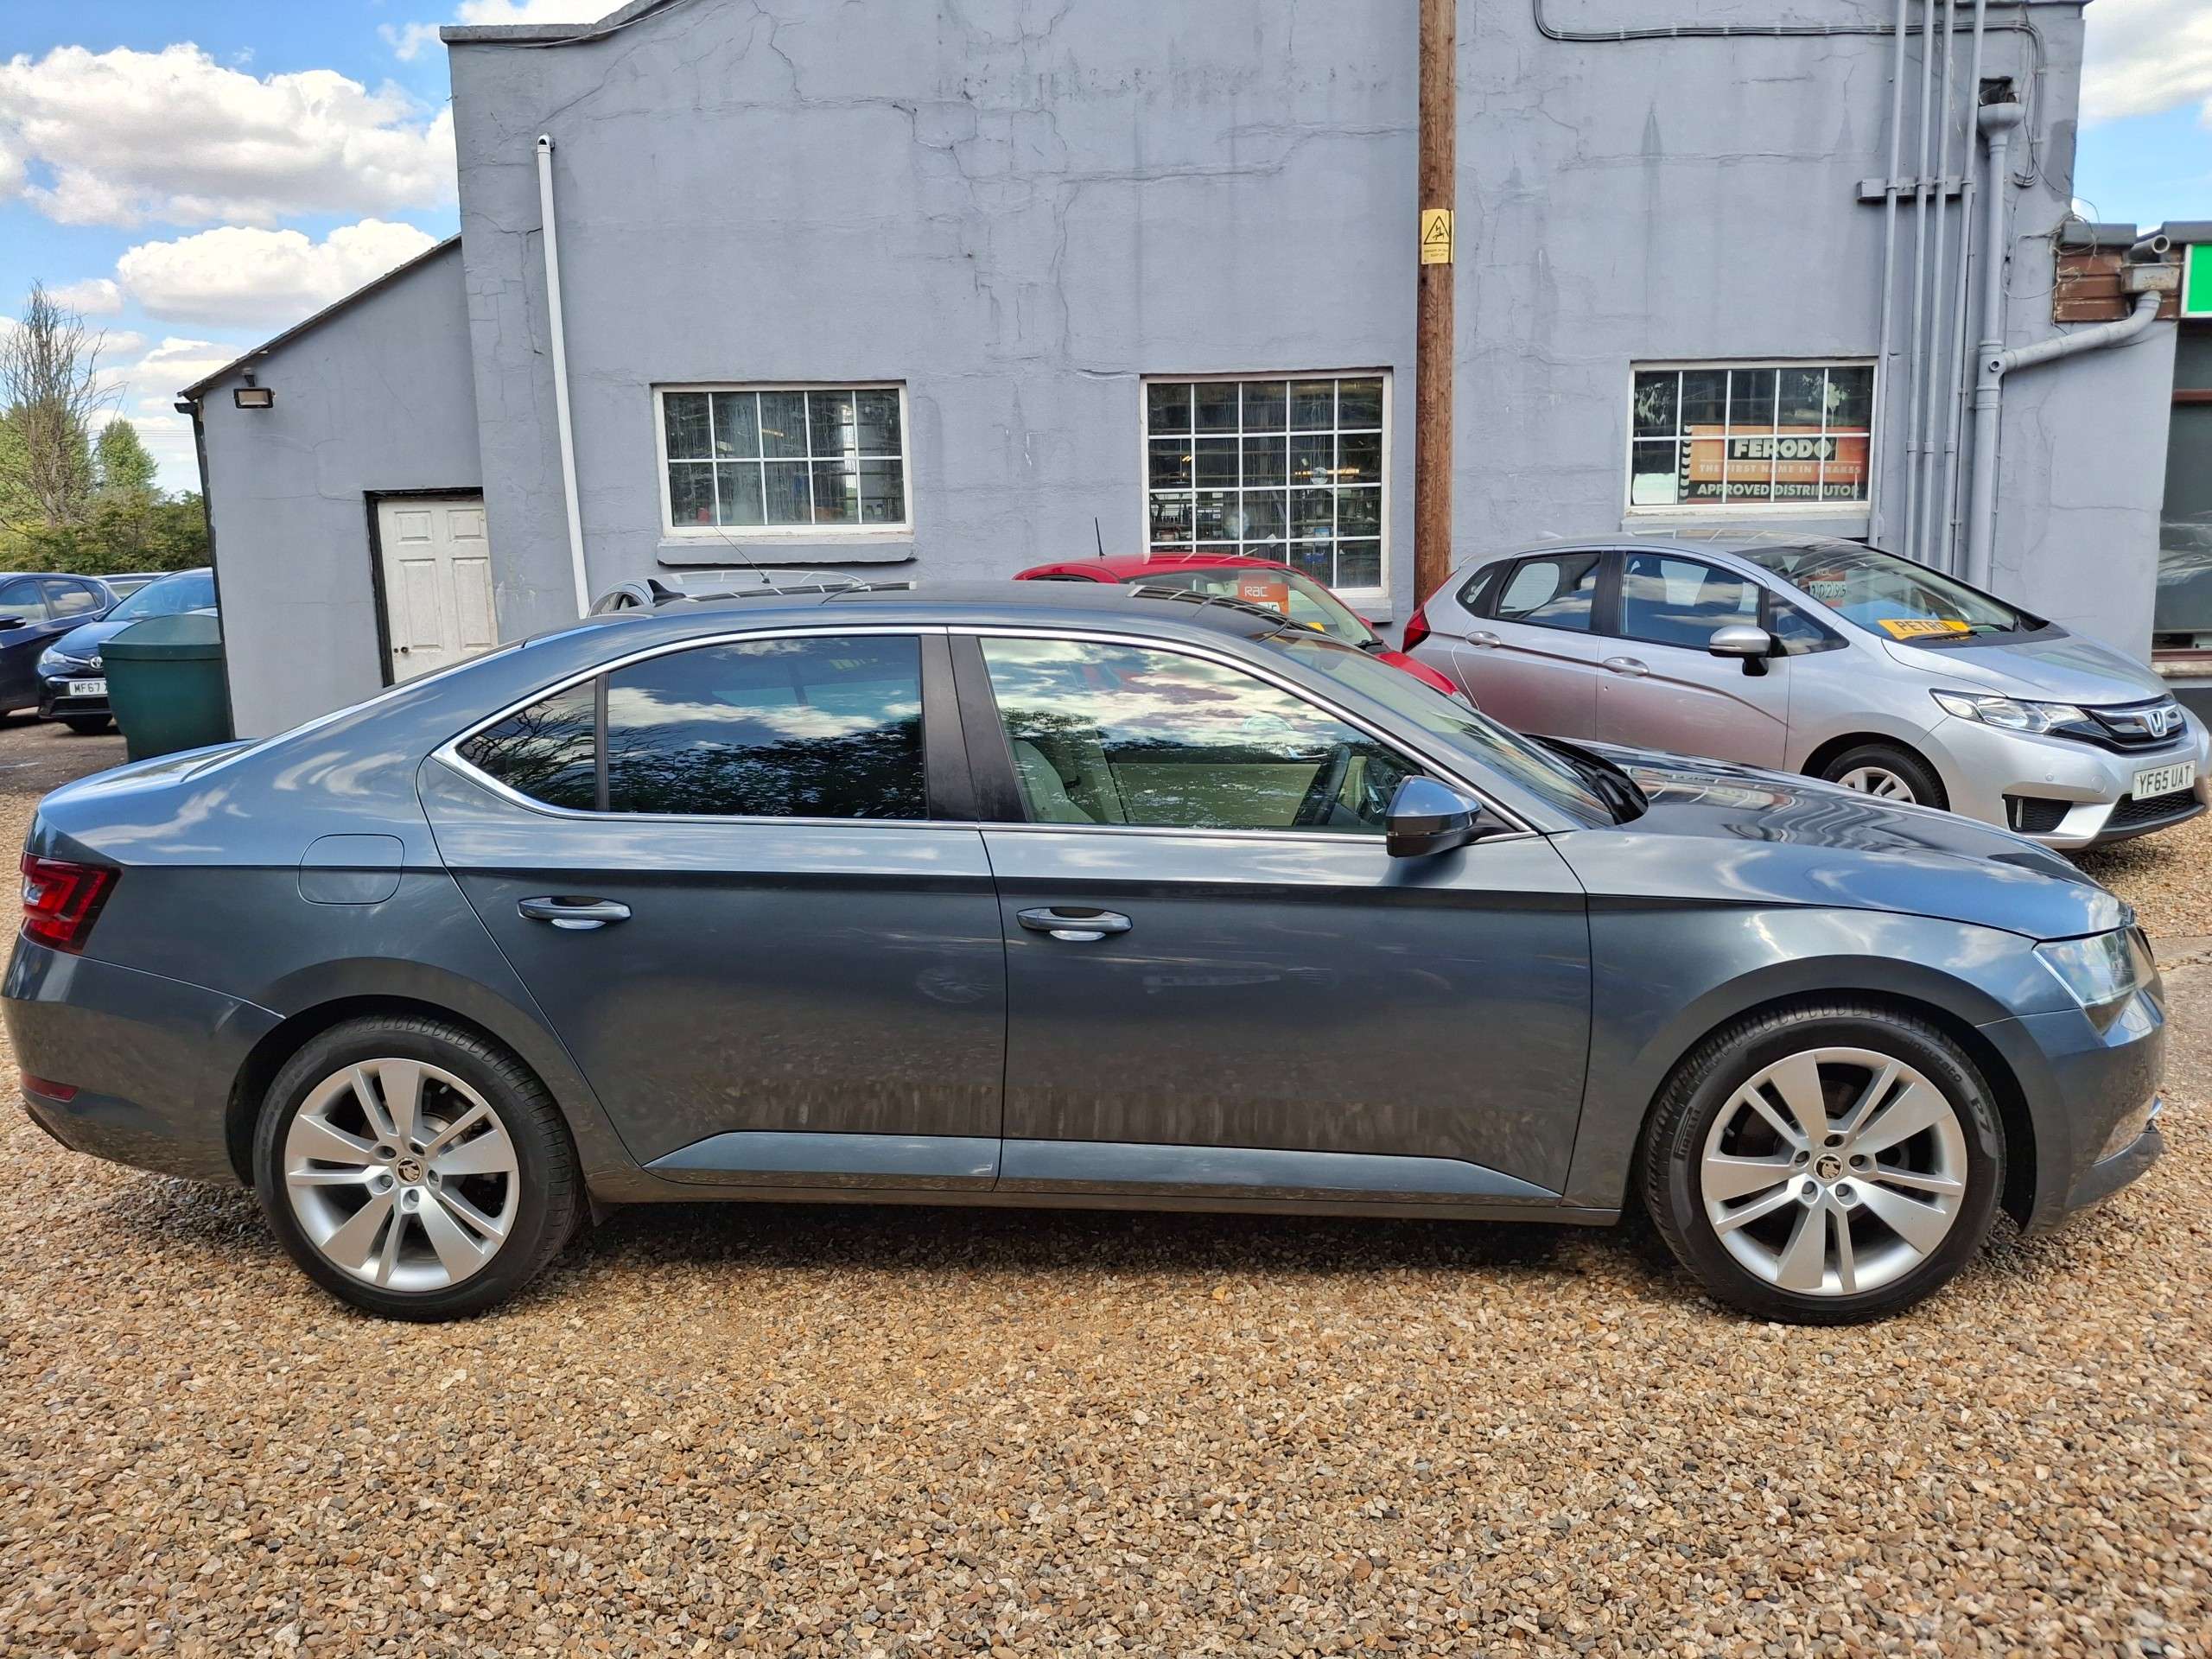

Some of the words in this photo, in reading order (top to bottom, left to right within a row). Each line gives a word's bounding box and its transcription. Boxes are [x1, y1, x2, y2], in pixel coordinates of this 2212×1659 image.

[1734, 439, 1832, 458] FERODO
[1697, 484, 1770, 496] APPROVED
[74, 683, 100, 693] MF67
[2139, 770, 2169, 794] YF65
[2171, 766, 2190, 787] UAT
